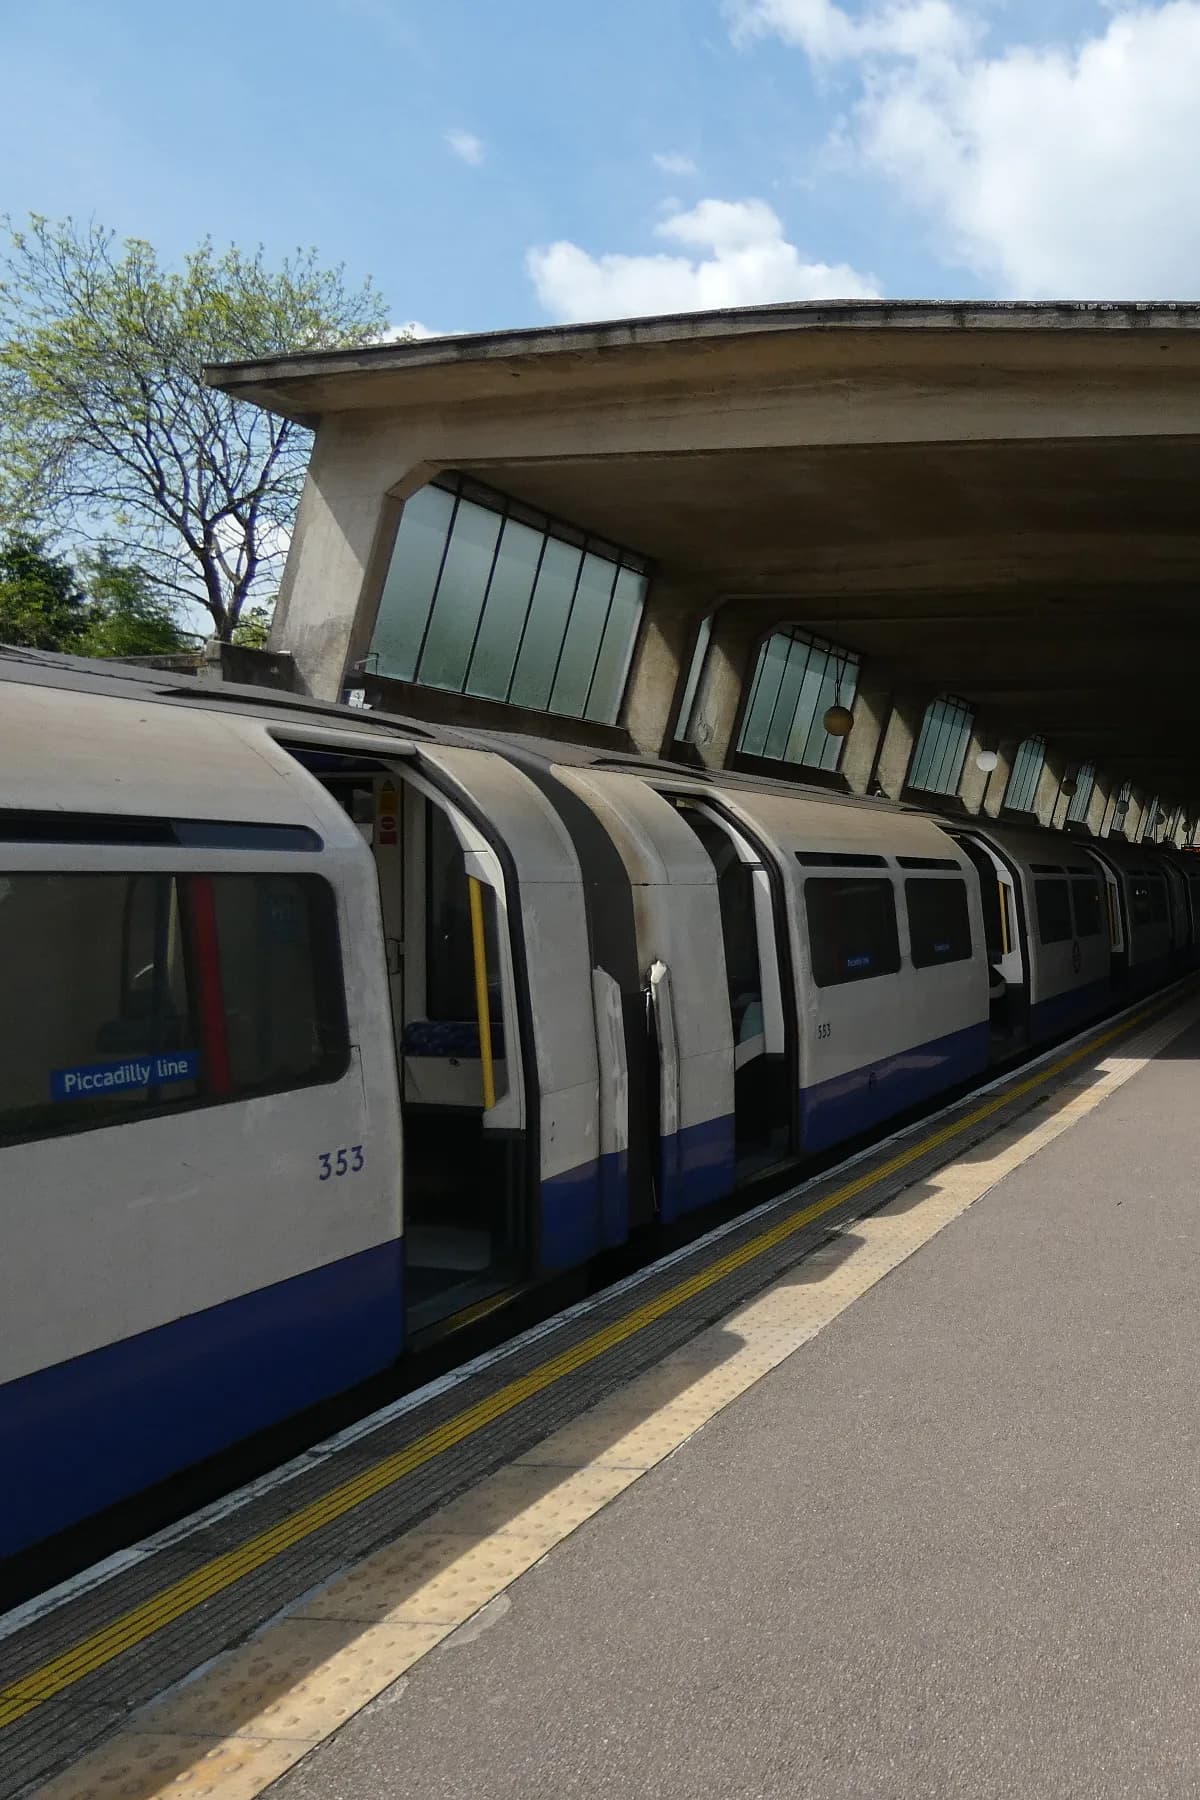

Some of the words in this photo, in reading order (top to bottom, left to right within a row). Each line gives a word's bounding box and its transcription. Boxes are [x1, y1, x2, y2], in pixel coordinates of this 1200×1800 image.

[64, 1063, 151, 1093] Piccadilly
[156, 1059, 189, 1077] line
[318, 1144, 364, 1181] 353
